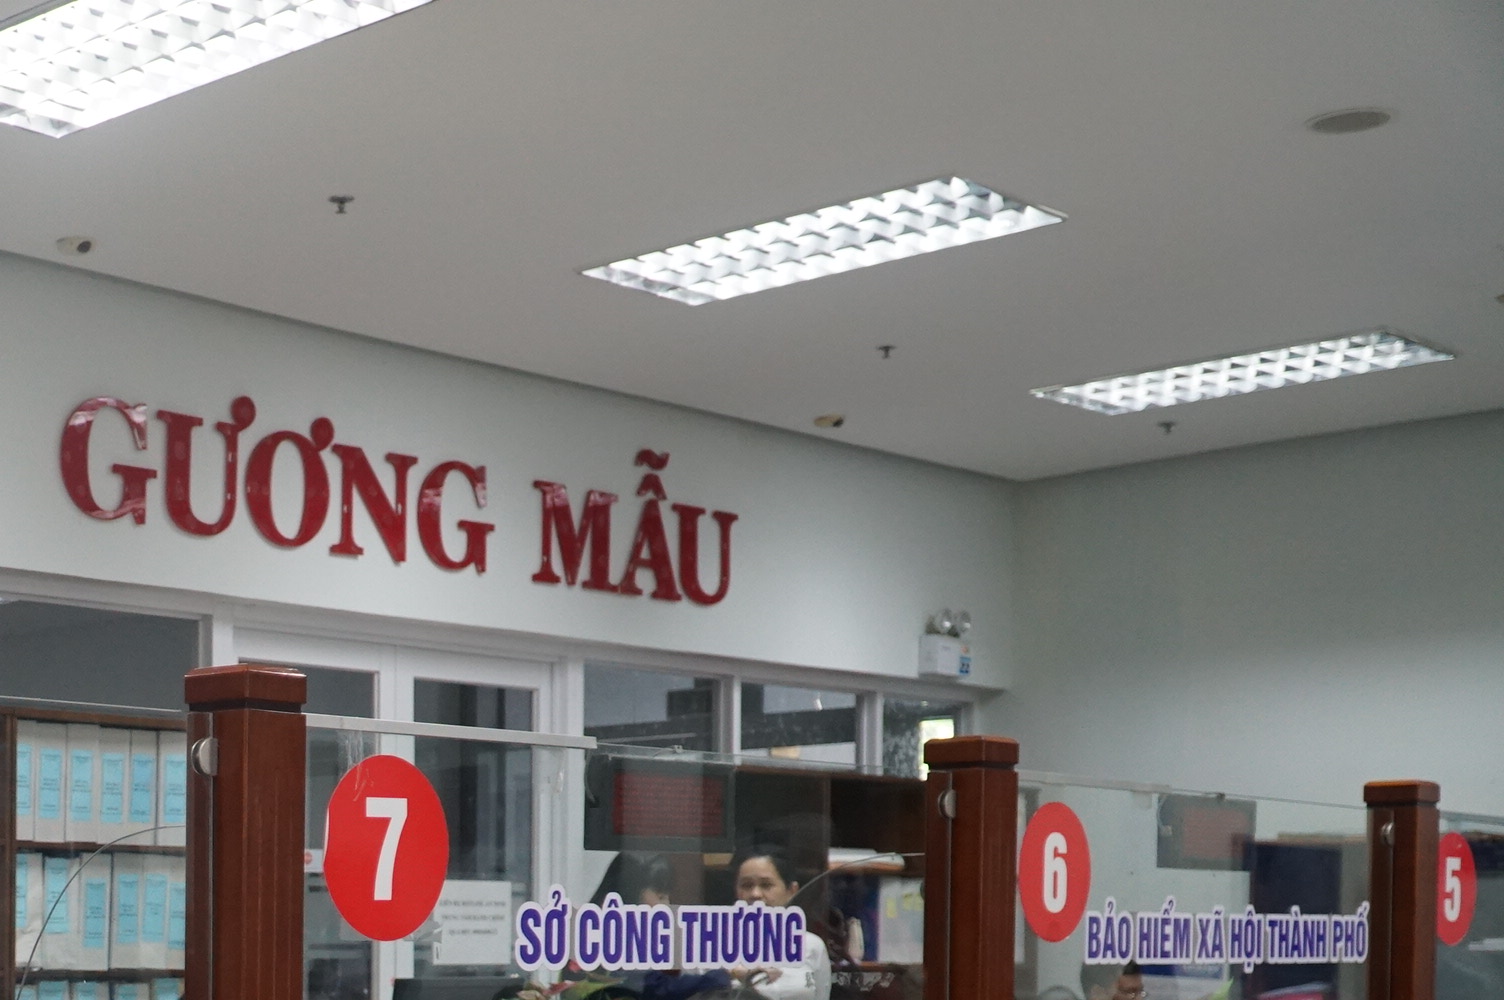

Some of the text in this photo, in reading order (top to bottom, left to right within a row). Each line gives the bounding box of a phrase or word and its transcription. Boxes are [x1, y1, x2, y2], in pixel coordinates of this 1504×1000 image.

[60, 395, 739, 606] GƯƠNG MẪU
[365, 797, 408, 901] 7
[1043, 831, 1067, 914] 6
[519, 890, 567, 965] SỞ
[579, 899, 670, 965] CÔNG
[682, 906, 803, 963] THƯƠNG
[1445, 857, 1461, 922] 5
[1088, 900, 1367, 968] BẢO HIỂM XÃ HỘI THÀNH PHỐ
